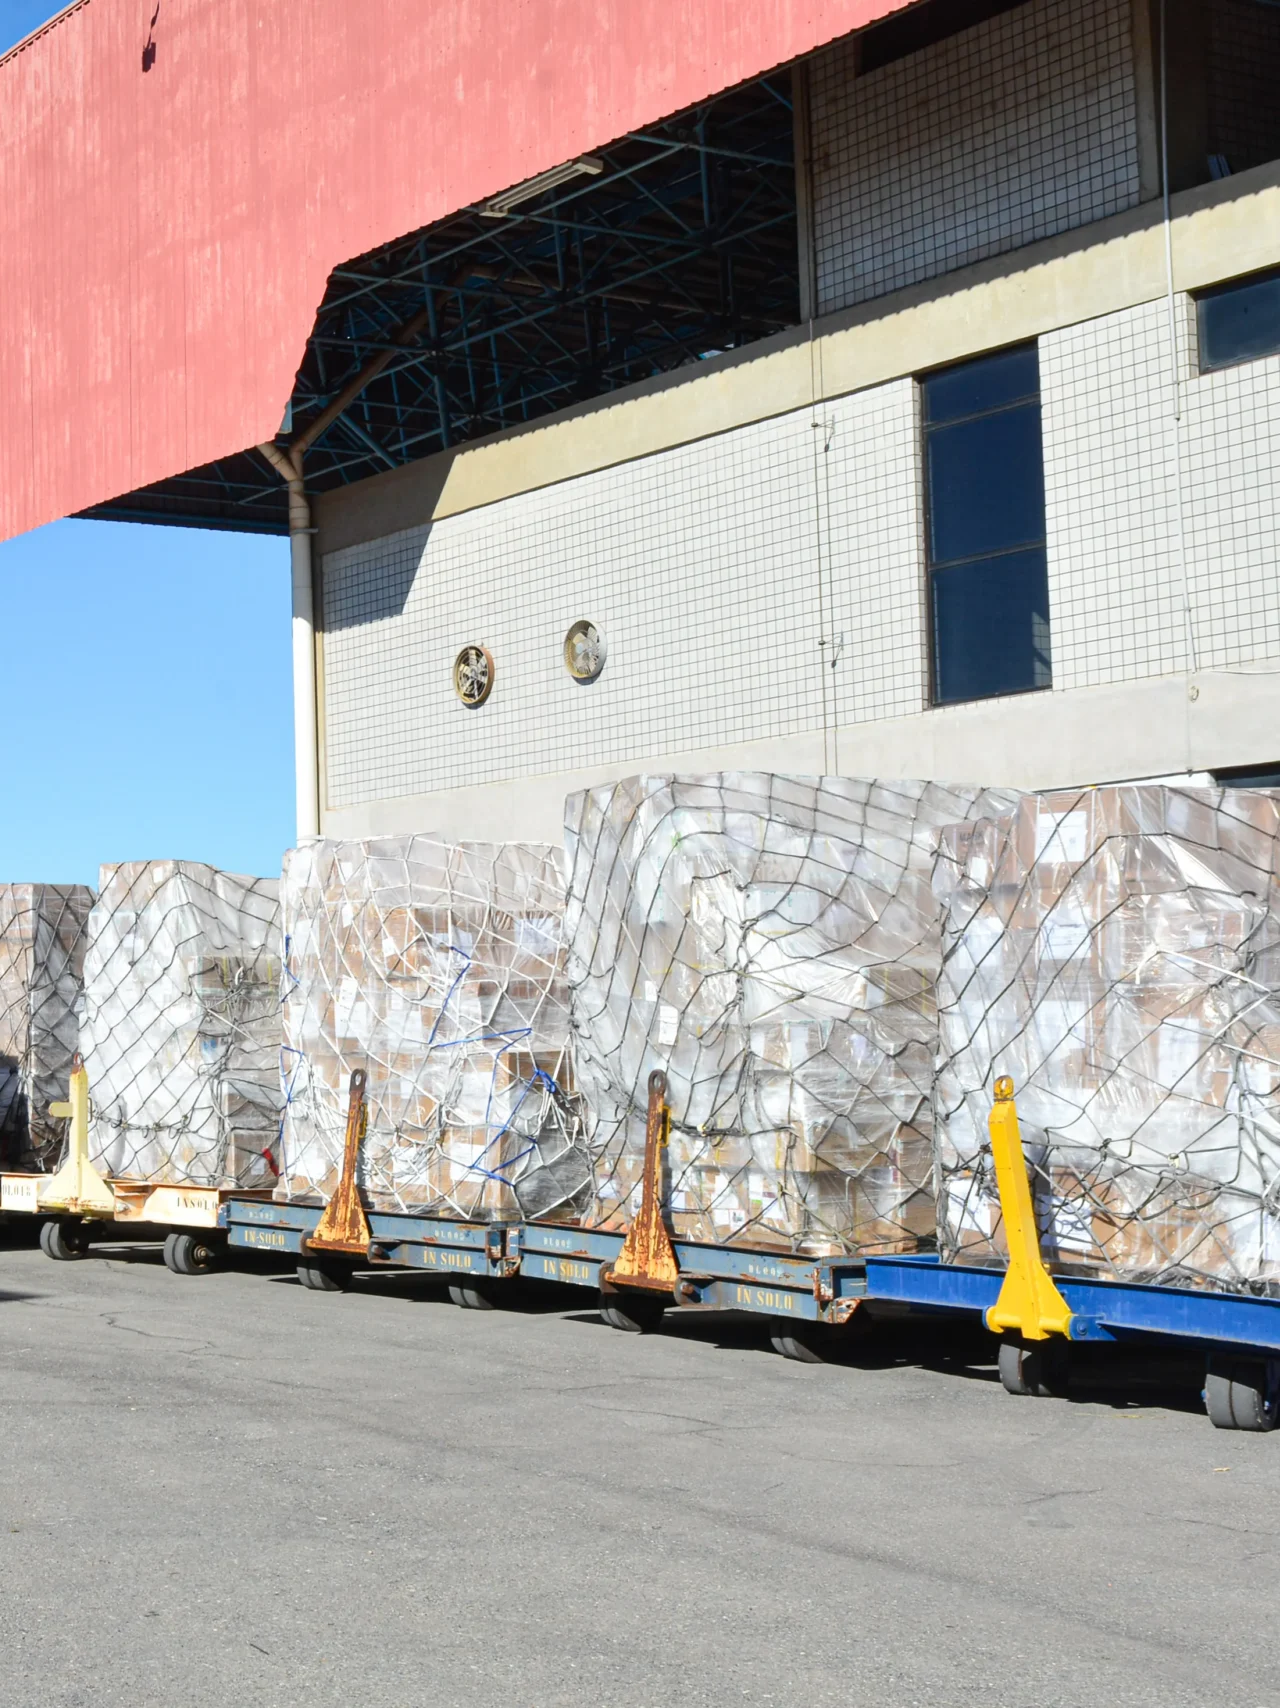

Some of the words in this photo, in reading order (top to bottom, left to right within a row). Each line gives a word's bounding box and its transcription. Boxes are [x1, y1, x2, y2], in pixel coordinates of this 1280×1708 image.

[259, 1231, 285, 1247] SOLO
[423, 1250, 437, 1265] IN
[440, 1252, 472, 1268] SOLO
[543, 1259, 556, 1275] IN
[560, 1261, 589, 1280] SOLO
[737, 1287, 752, 1305] IN
[757, 1290, 794, 1310] SOLO
